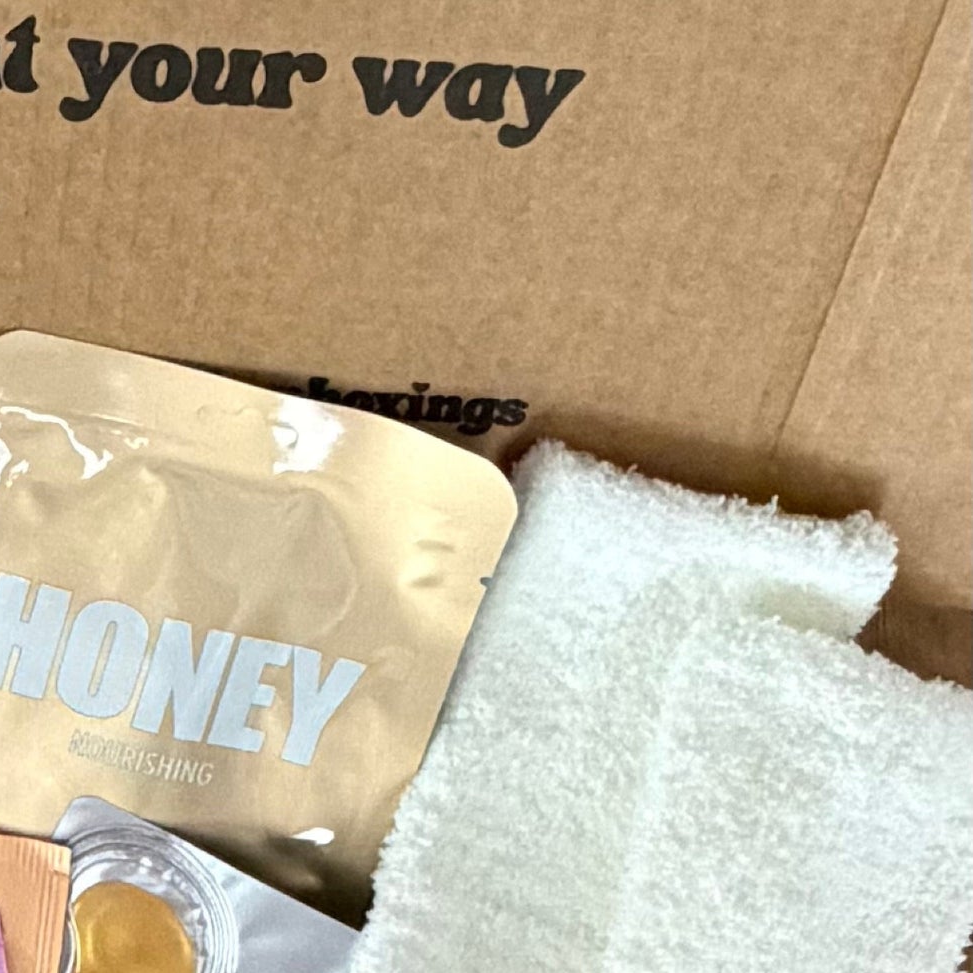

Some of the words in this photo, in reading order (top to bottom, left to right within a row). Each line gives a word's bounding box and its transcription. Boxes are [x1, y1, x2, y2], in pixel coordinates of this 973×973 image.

[59, 38, 326, 122] your
[352, 56, 585, 148] way
[69, 729, 214, 786] NOURISHING
